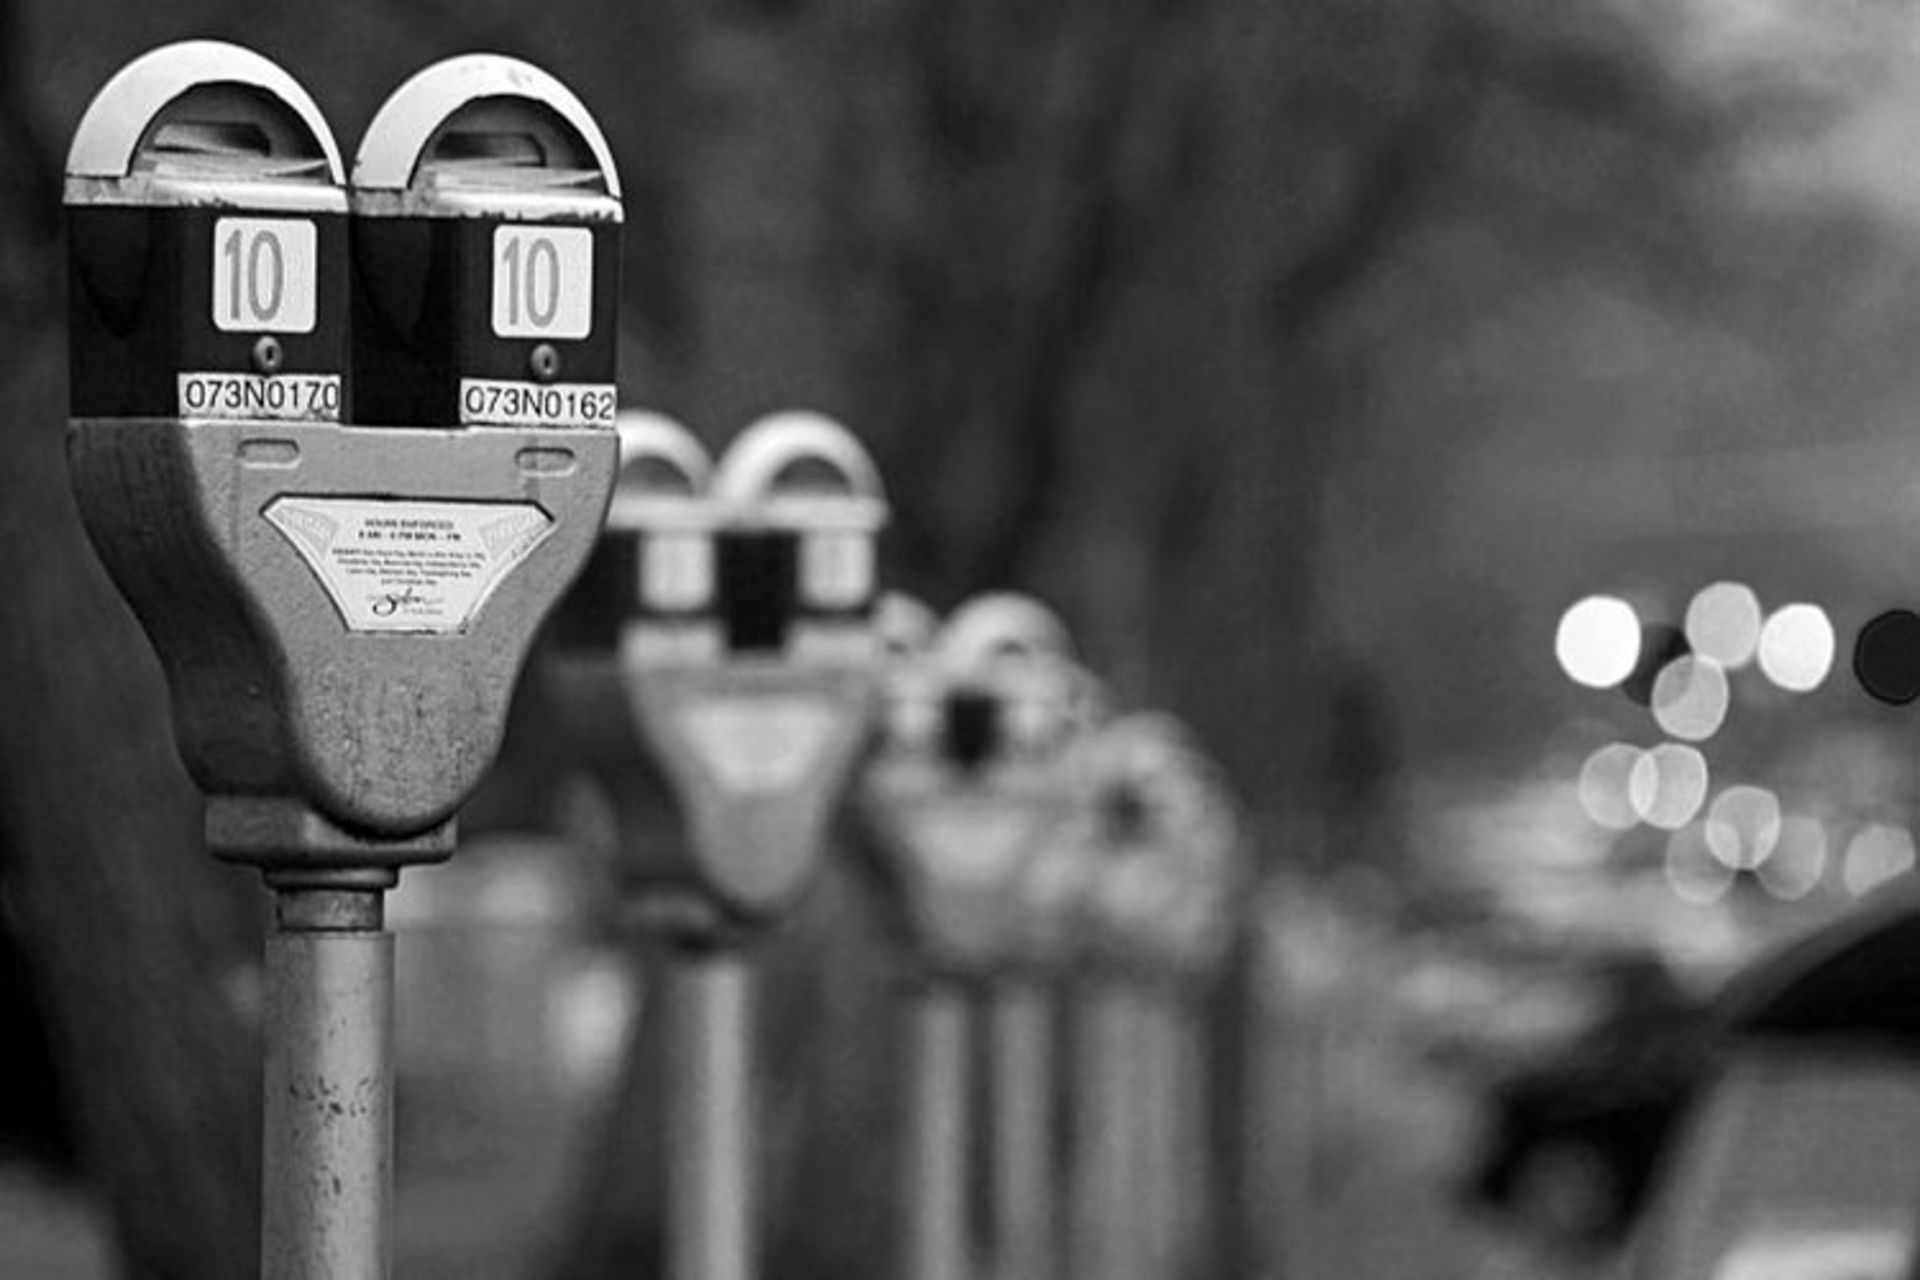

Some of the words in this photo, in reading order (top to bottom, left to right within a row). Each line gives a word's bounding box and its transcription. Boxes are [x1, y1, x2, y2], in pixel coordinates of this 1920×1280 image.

[224, 229, 284, 322] 10
[502, 236, 560, 328] 10
[185, 380, 339, 411] 073N0170
[465, 386, 614, 420] 073N0162
